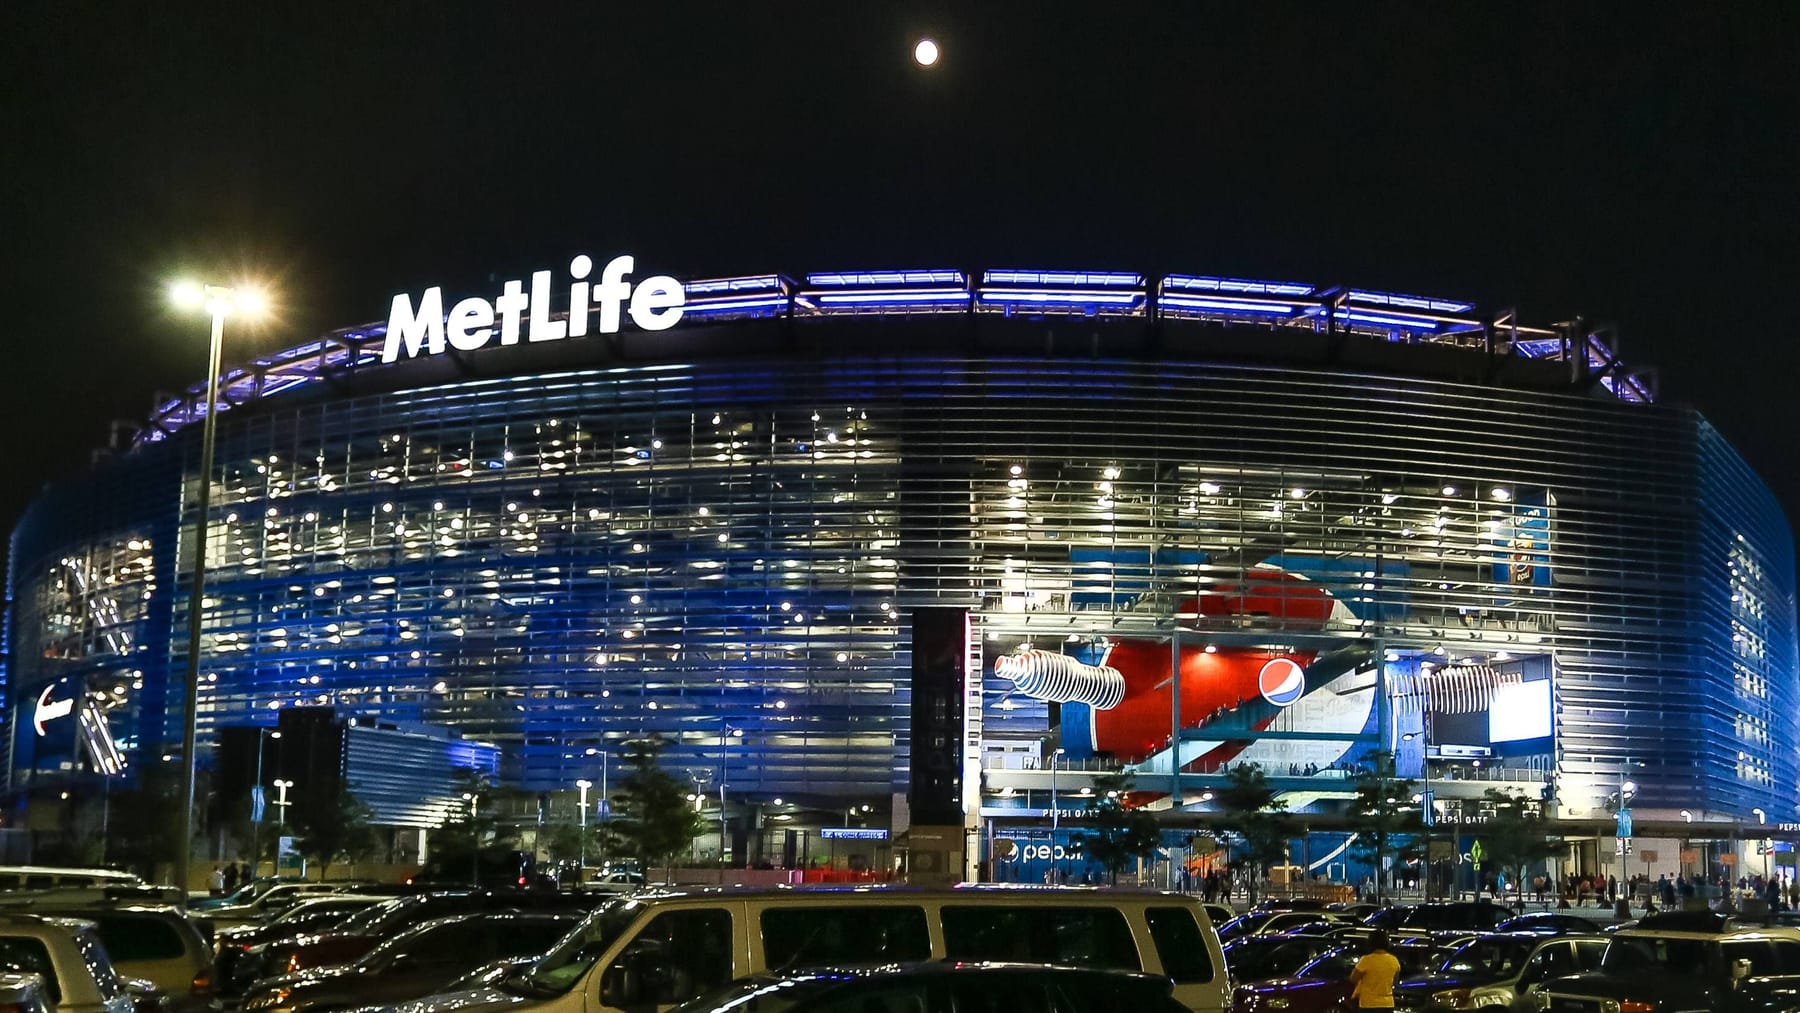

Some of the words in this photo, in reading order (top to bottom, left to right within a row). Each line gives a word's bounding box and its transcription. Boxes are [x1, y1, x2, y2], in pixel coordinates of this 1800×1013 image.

[381, 255, 686, 364] MetLife
[1042, 809, 1072, 818] PEPSI
[1435, 815, 1462, 824] PEPSI
